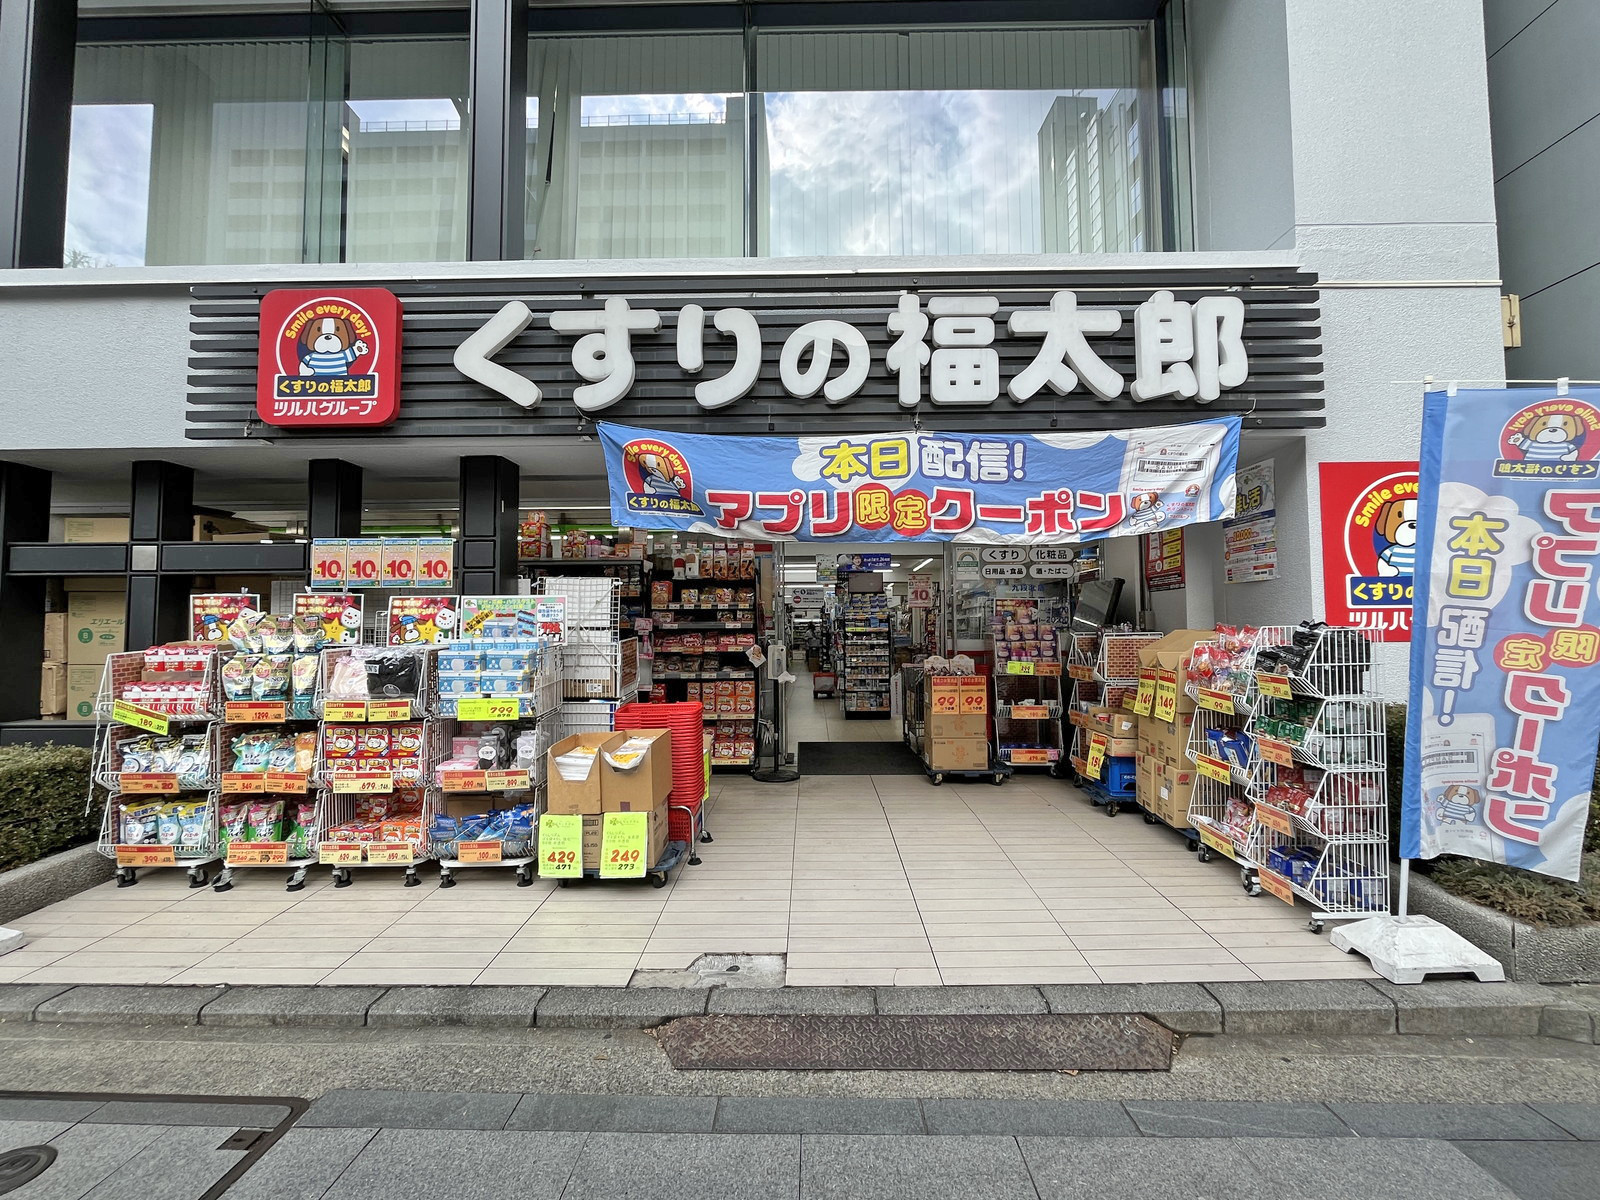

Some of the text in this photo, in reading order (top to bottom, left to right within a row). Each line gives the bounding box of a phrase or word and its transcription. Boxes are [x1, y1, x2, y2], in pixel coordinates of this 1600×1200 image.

[285, 305, 372, 339] Smile every day!
[453, 290, 1249, 411] くすりの福太郎
[279, 379, 372, 393] くすりの福太郎
[273, 400, 378, 417] ツルハグループ
[640, 444, 670, 457] every
[668, 453, 687, 474] day!
[629, 496, 700, 512] くすりの福太郎
[1355, 488, 1392, 528] Smile
[706, 487, 1127, 536] アプリ限定クーポン
[988, 550, 1020, 560] くすり
[1035, 549, 1069, 560] 化粧品
[985, 567, 1024, 575] 日用品・食品
[1035, 567, 1069, 575] 酒・たばこ
[90, 618, 125, 626] エリエール
[937, 696, 956, 706] 99
[965, 696, 984, 706] 99
[1215, 701, 1223, 709] 99
[490, 706, 513, 714] 799
[140, 718, 152, 727] 189
[361, 782, 375, 790] 679
[144, 855, 158, 863] 399
[547, 850, 576, 863] 429
[610, 849, 640, 863] 249
